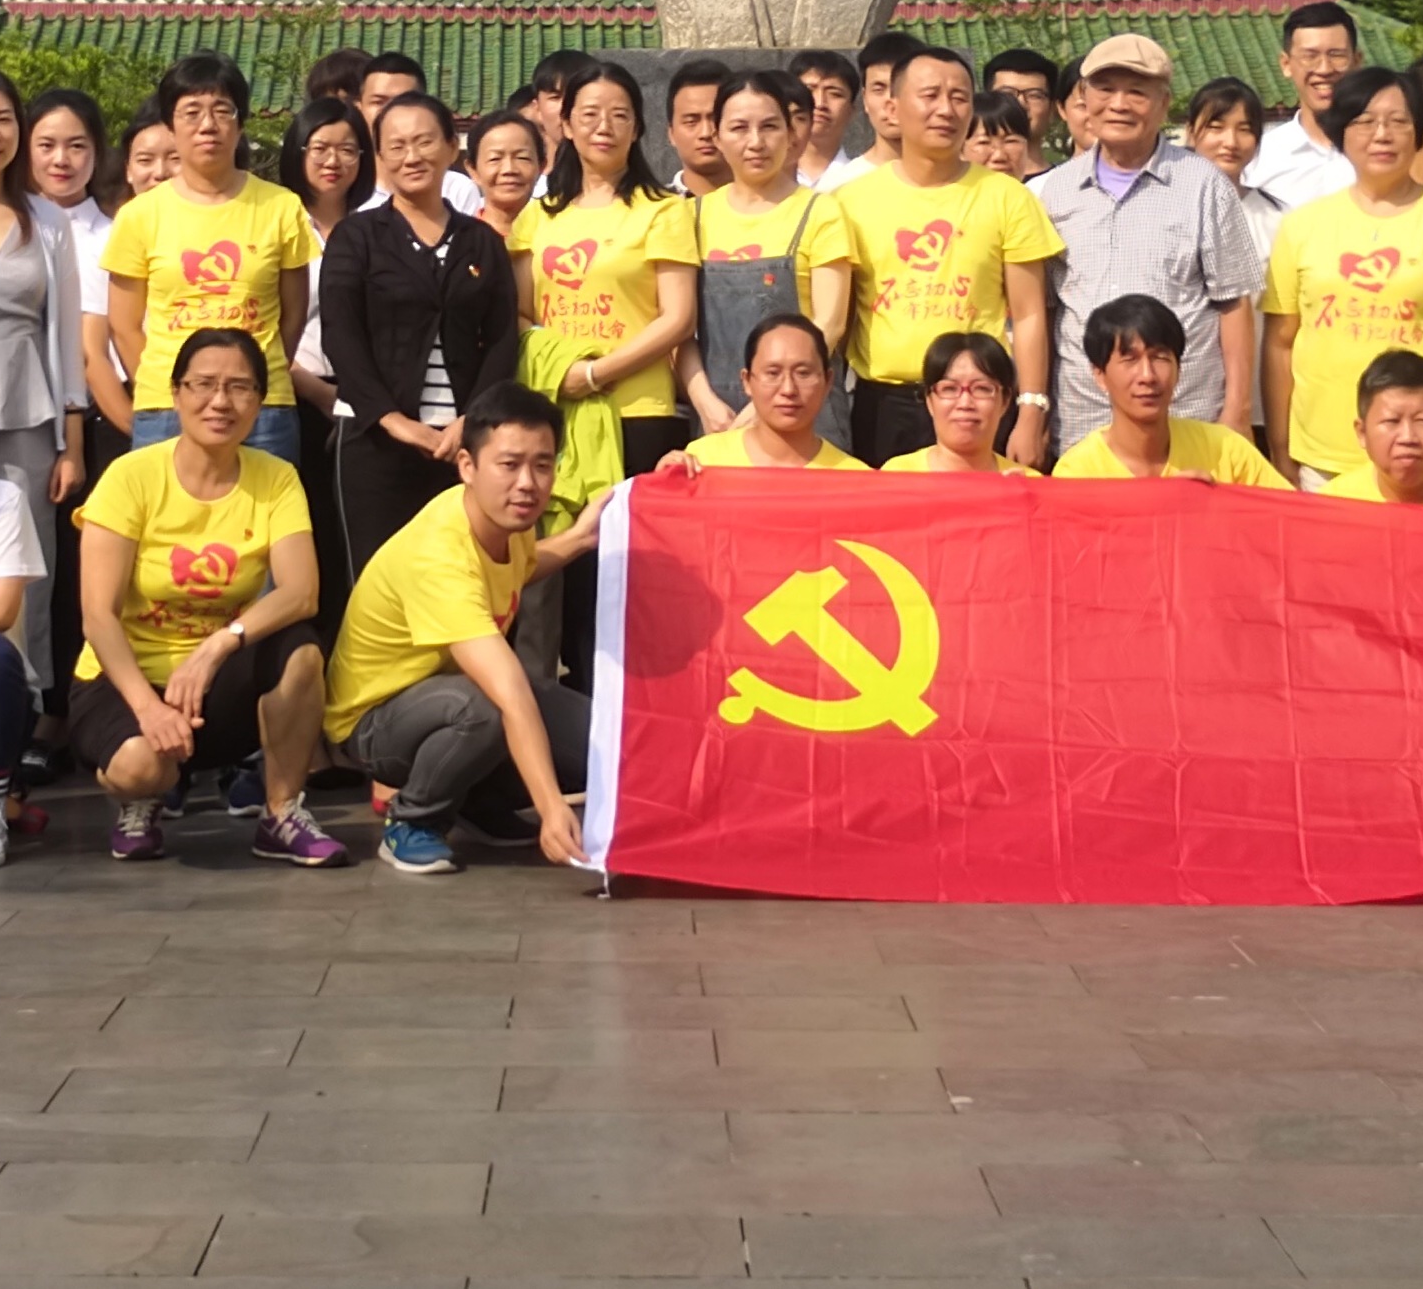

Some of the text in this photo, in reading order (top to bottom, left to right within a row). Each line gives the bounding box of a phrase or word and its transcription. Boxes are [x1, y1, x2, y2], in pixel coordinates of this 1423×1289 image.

[871, 275, 971, 314] 不忘初心
[1314, 293, 1420, 329] 不忘初心
